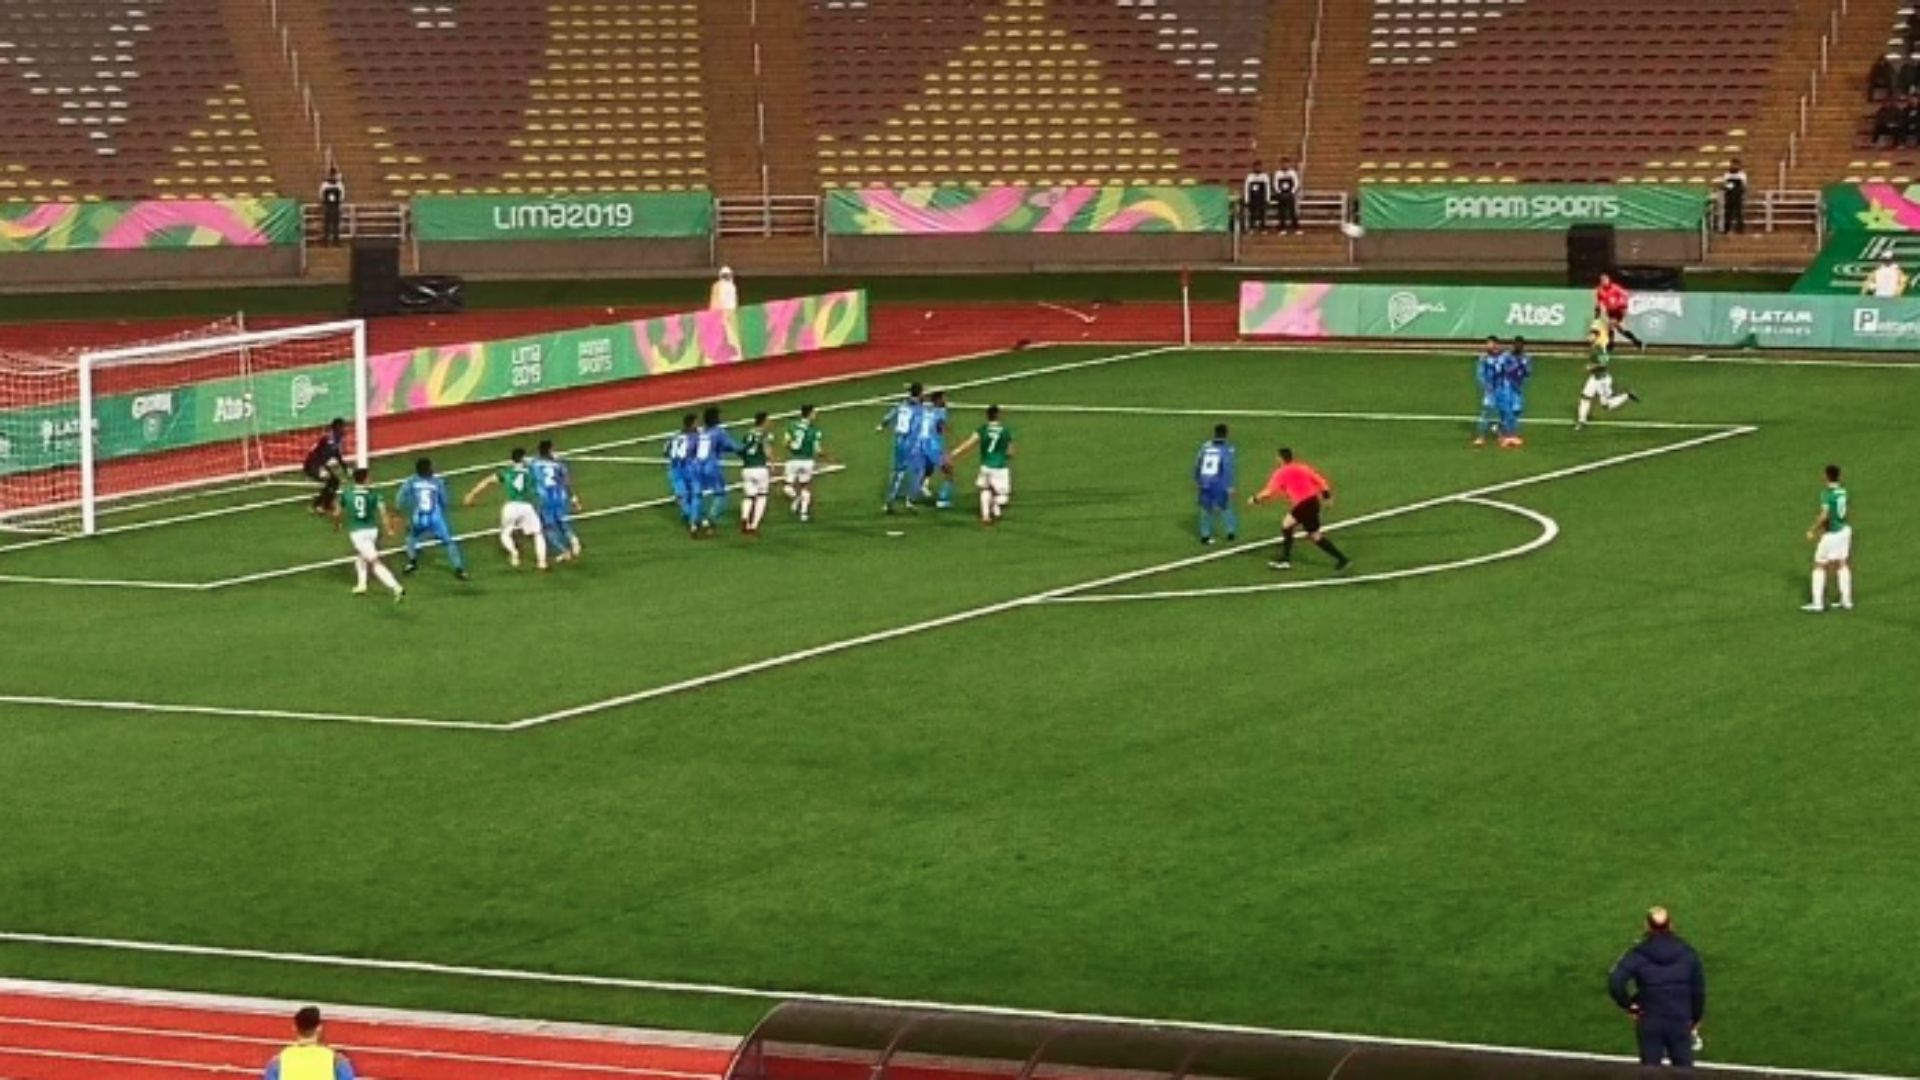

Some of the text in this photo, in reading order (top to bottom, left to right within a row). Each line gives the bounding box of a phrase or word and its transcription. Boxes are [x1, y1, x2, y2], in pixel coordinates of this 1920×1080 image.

[1446, 195, 1620, 218] PANAM SPORTS
[1751, 309, 1814, 323] LATAM
[988, 432, 999, 452] 7
[512, 473, 524, 491] 4
[354, 496, 366, 518] 9
